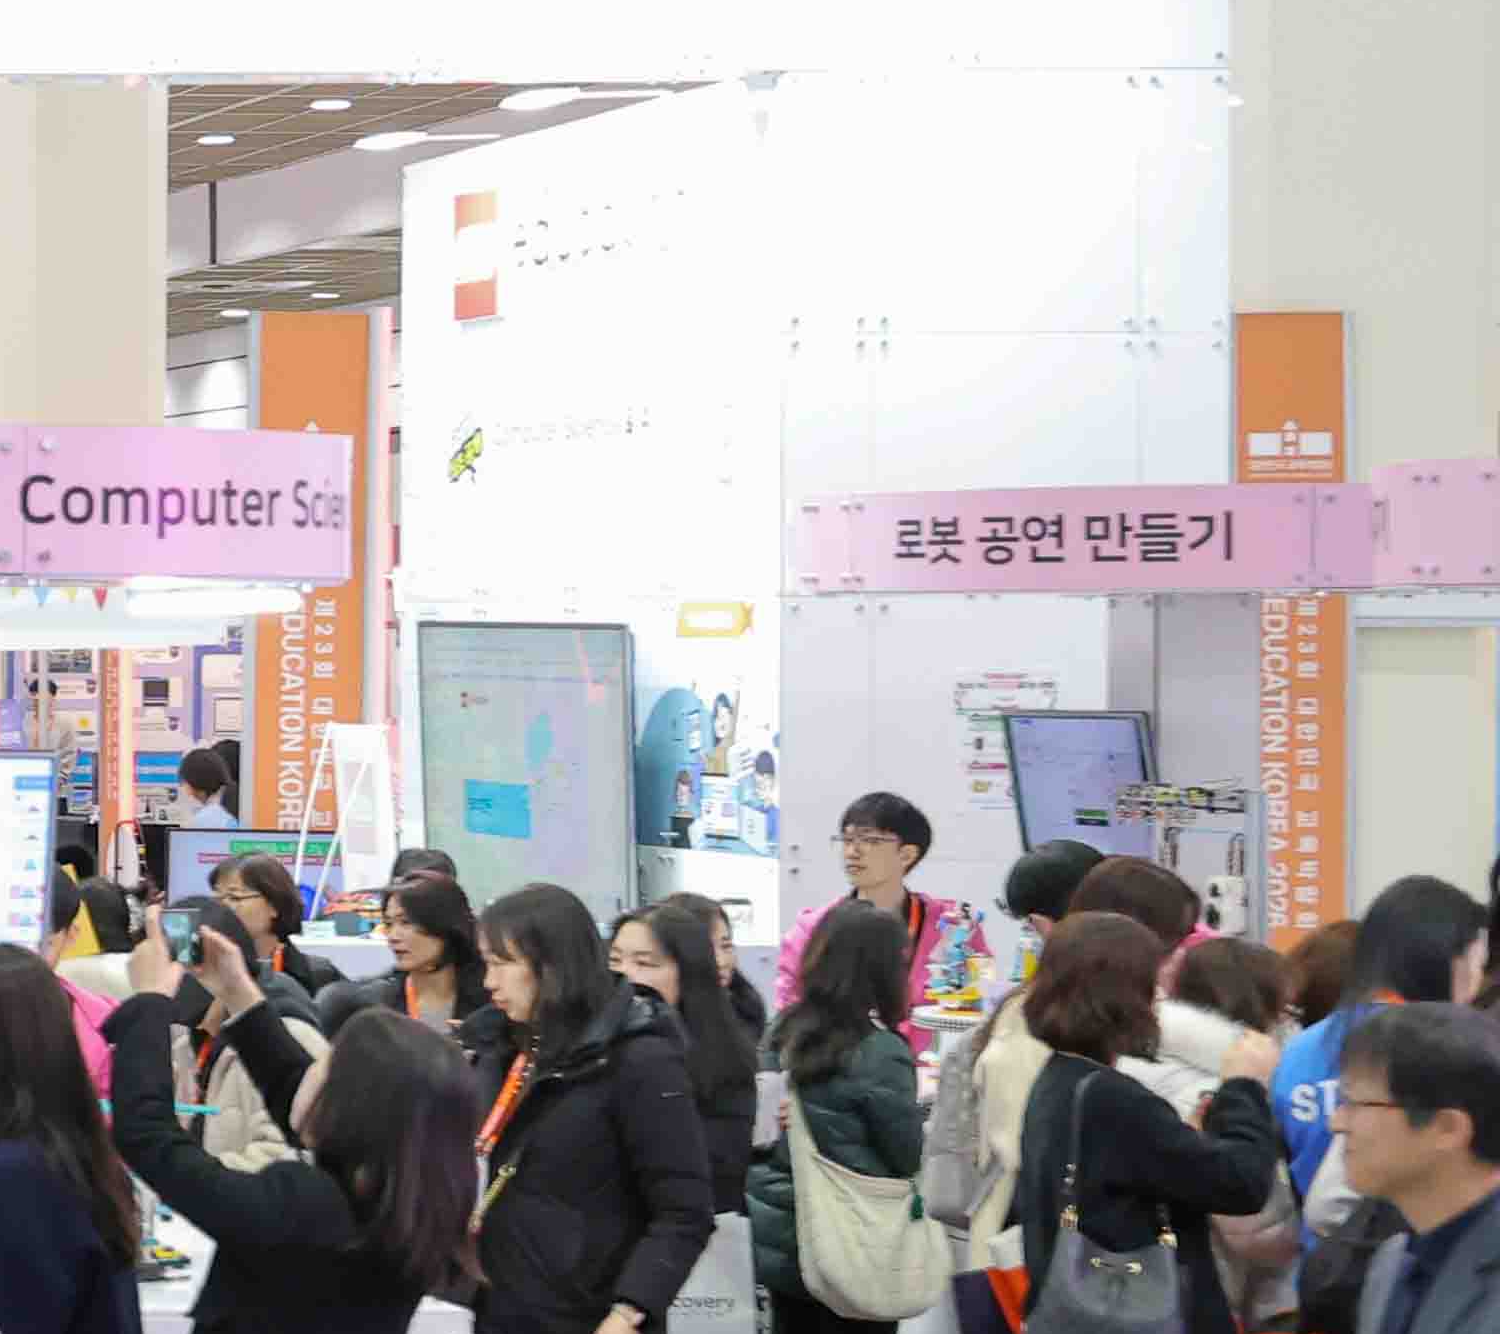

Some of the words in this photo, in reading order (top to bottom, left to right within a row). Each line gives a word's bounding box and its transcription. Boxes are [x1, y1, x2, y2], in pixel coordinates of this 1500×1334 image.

[18, 473, 282, 539] Computer
[893, 517, 966, 565] 로봇
[976, 514, 1067, 565] 공연
[1083, 510, 1236, 563] 만들기
[277, 610, 308, 754] DUCATION
[276, 760, 306, 832] KORE
